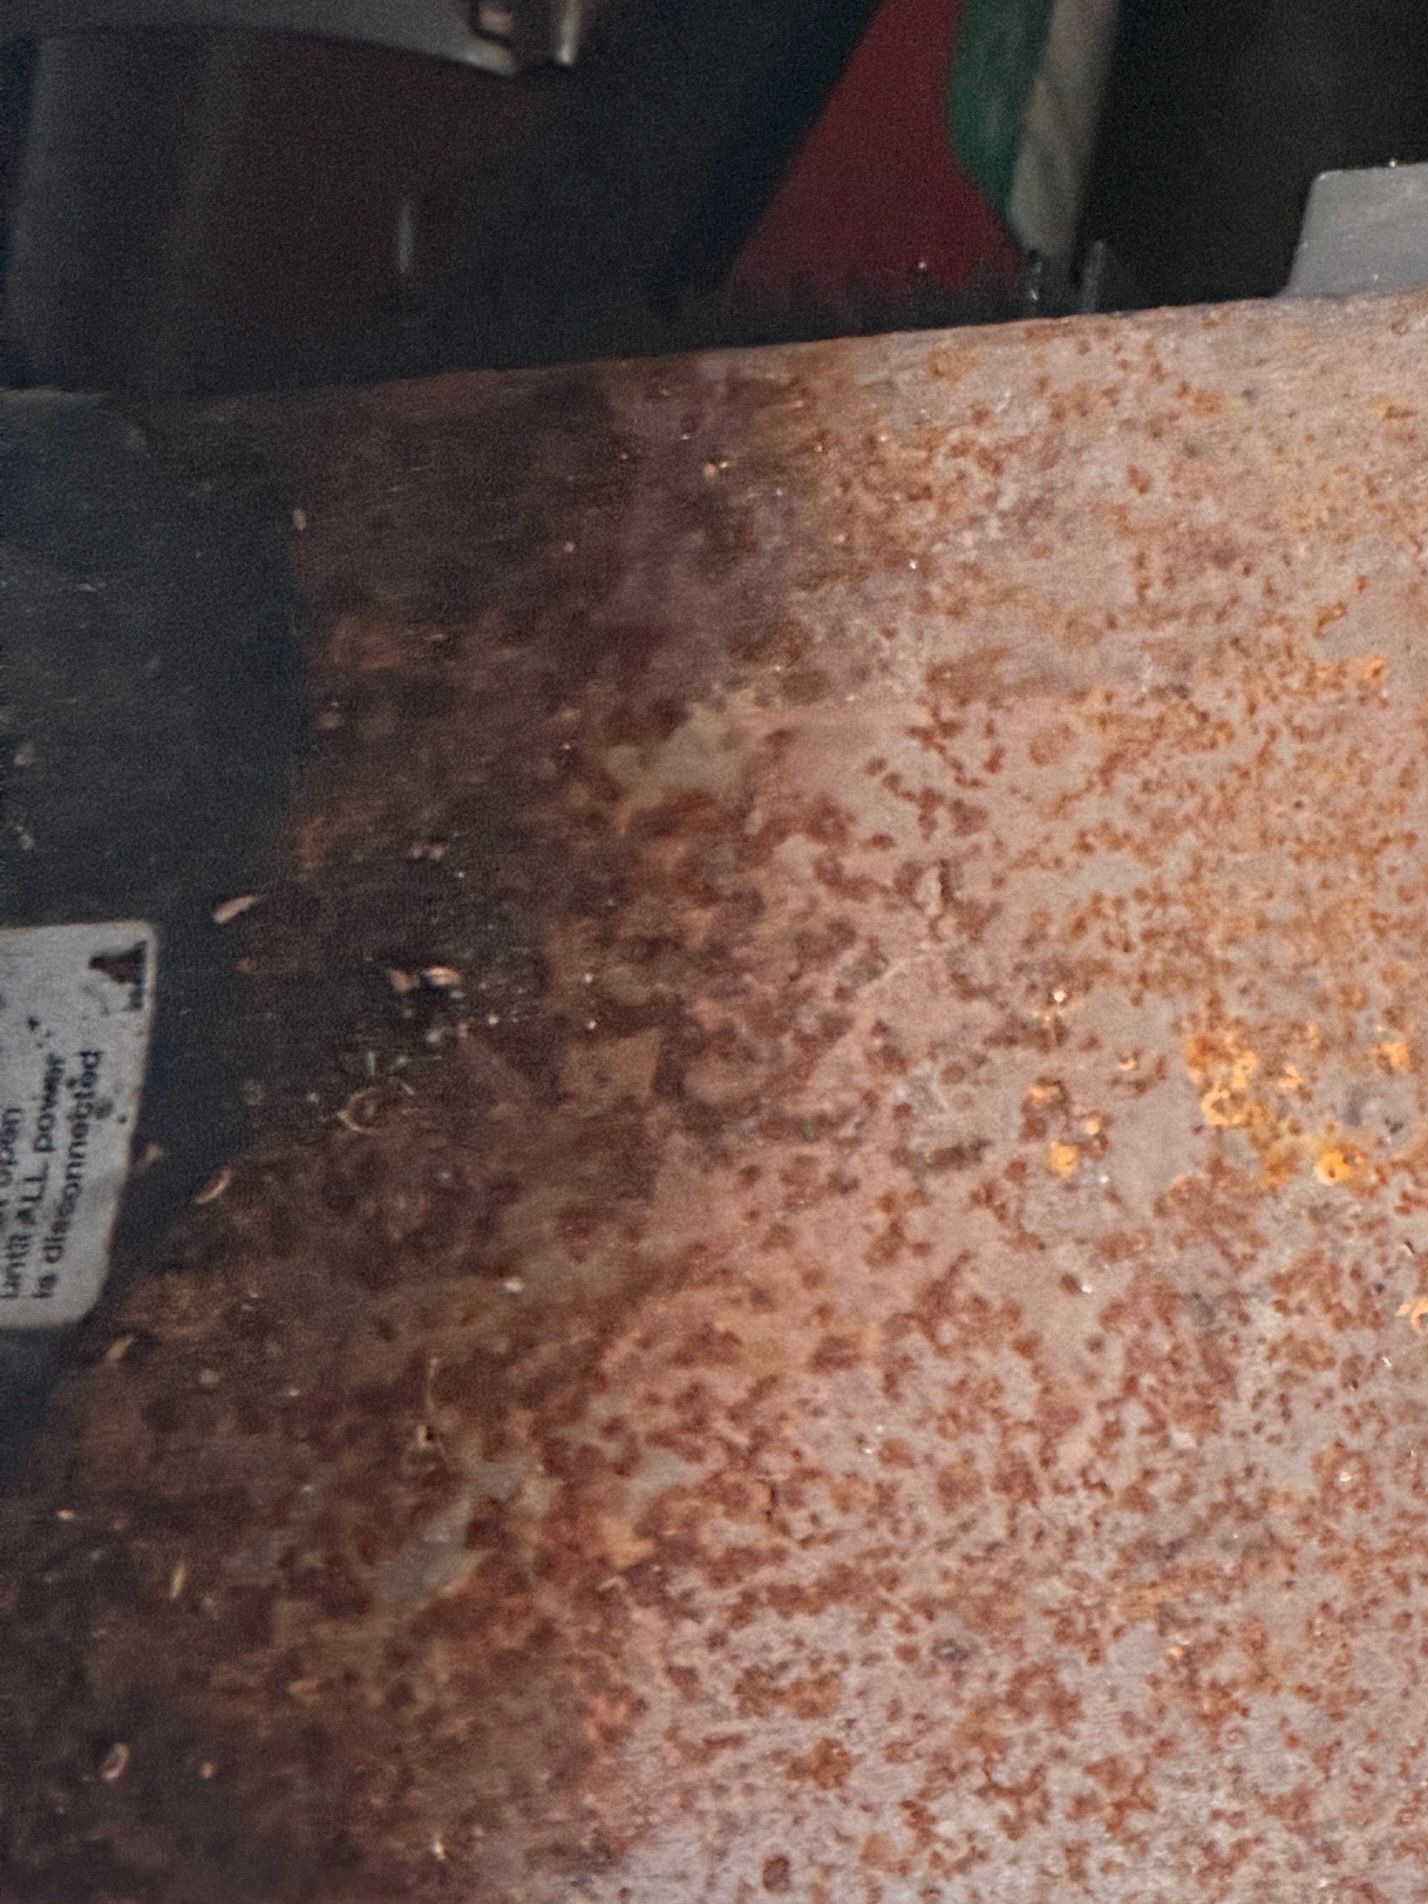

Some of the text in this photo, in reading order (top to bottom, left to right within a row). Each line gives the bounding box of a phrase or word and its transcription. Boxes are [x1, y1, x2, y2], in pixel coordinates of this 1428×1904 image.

[33, 1053, 65, 1154] power
[18, 1161, 49, 1225] ALL
[33, 1050, 102, 1300] is disconnected
